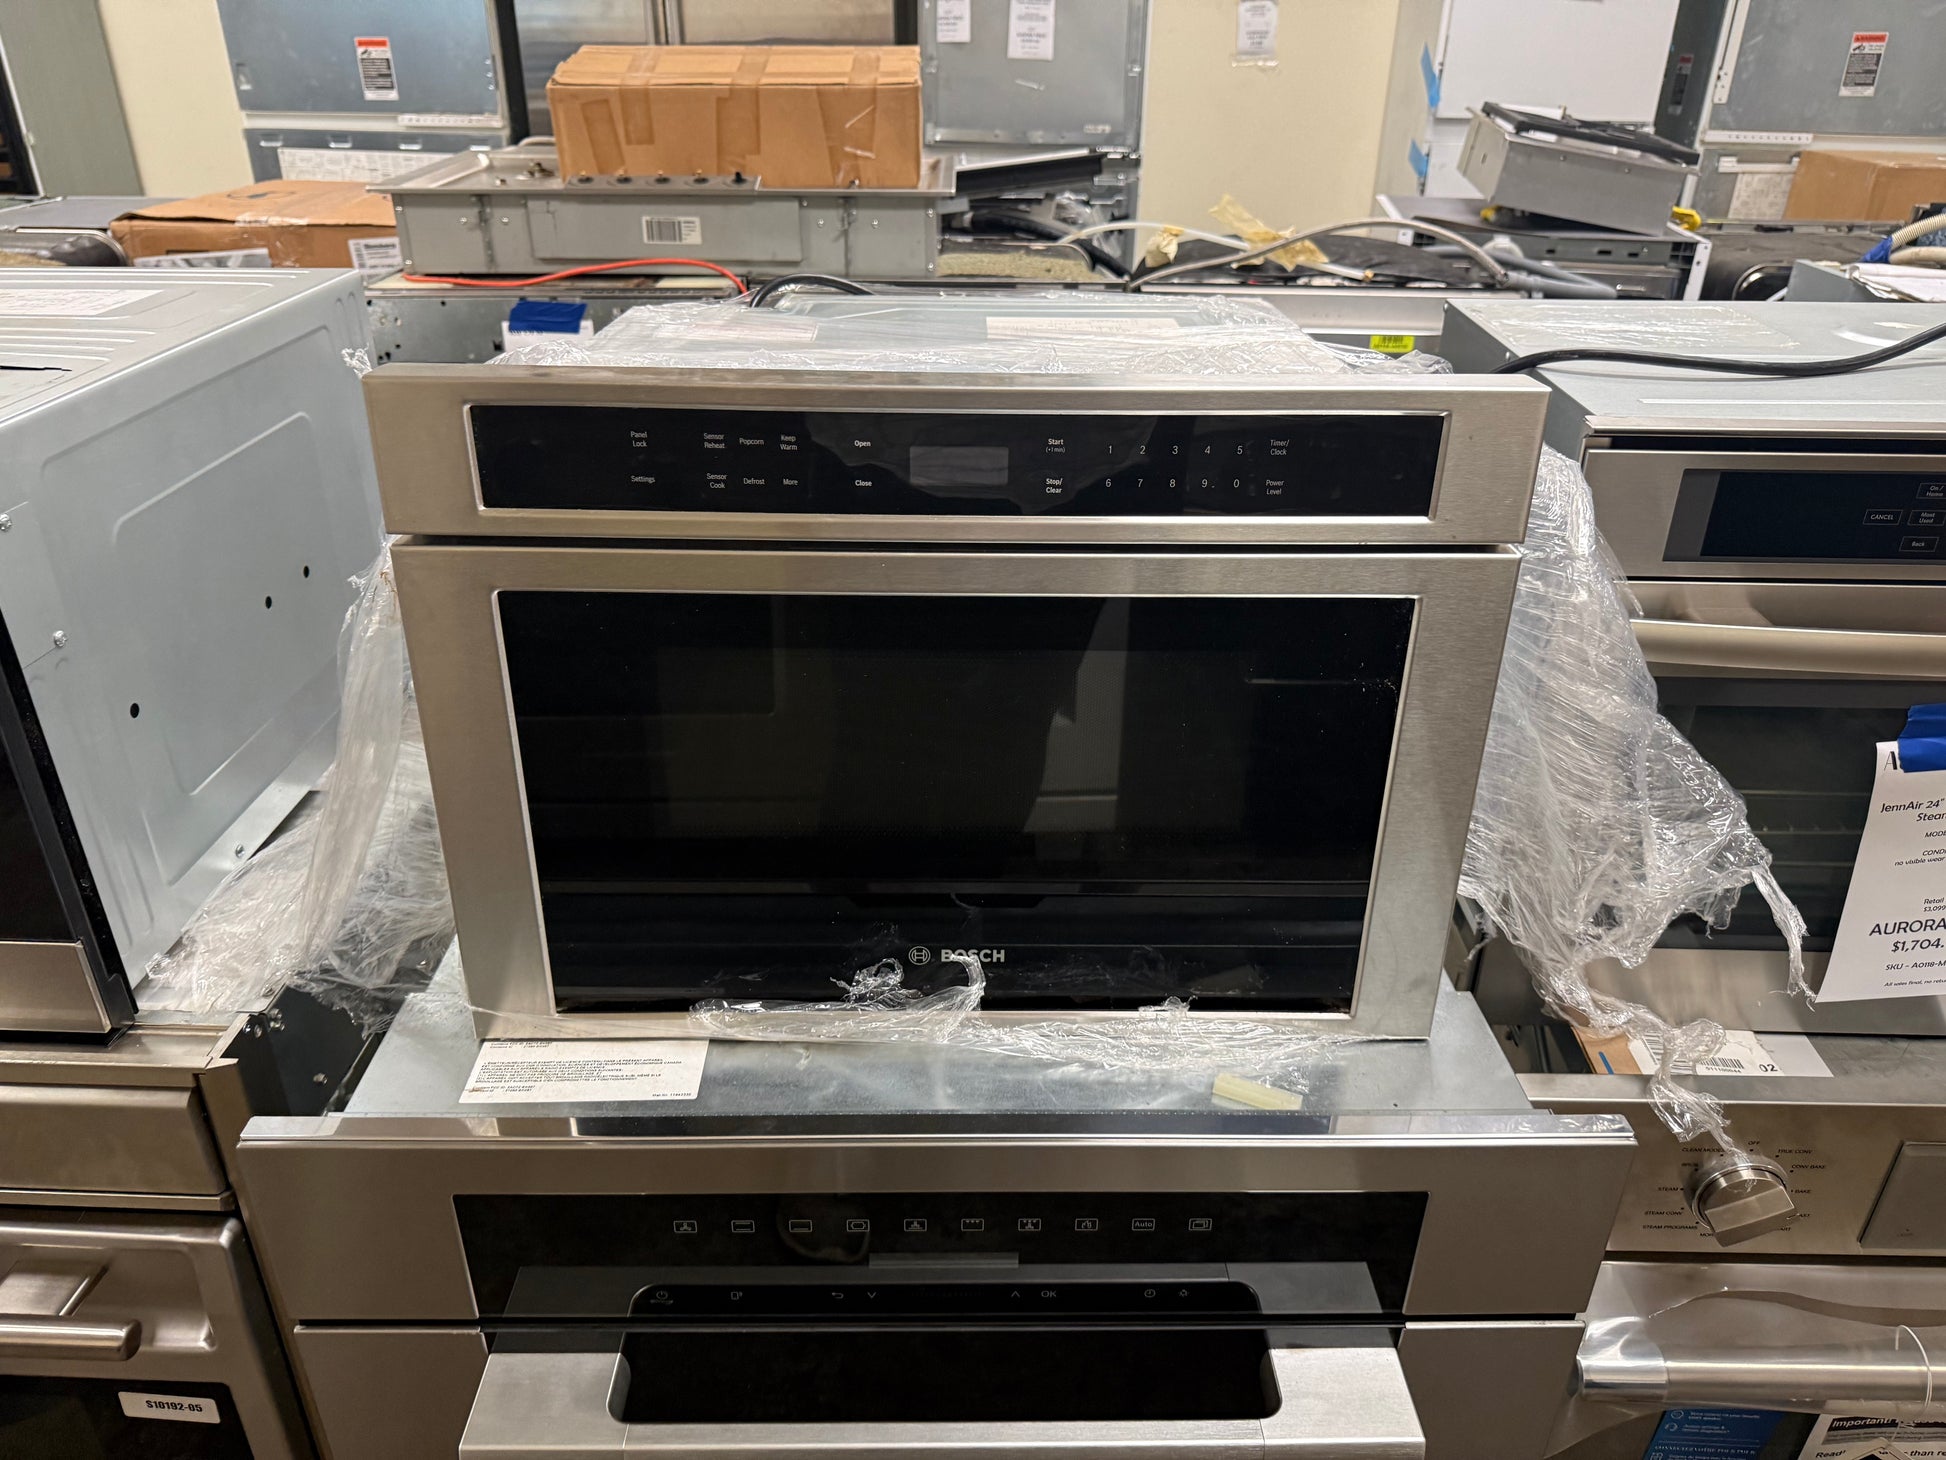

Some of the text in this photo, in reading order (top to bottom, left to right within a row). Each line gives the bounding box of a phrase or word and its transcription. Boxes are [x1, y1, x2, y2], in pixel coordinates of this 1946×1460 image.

[739, 438, 764, 447] Popcorn
[780, 434, 796, 443] Keep
[1270, 439, 1290, 447] Timer/
[632, 440, 647, 448] Lock
[704, 441, 725, 449] Reheat
[854, 440, 871, 448] Open
[1108, 446, 1113, 454] 1
[1140, 446, 1146, 455] 2
[1172, 446, 1178, 455] 3
[1204, 446, 1211, 455] 4
[1236, 446, 1243, 455] 5
[1270, 448, 1287, 456] Clock
[631, 475, 655, 484] Settings
[706, 473, 727, 481] Sensor
[1045, 477, 1063, 486] Stop/
[783, 478, 798, 486] More
[855, 479, 872, 487] Close
[1105, 479, 1112, 488] 6
[1137, 479, 1143, 488] 7
[1169, 479, 1176, 488] 8
[1201, 479, 1208, 488] 9
[1233, 479, 1240, 488] 0
[1265, 479, 1284, 487] Power
[1045, 486, 1062, 494] Clear
[1266, 488, 1282, 496] Level
[1880, 798, 1945, 813] JennAir 24"
[1923, 897, 1945, 905] Retail
[1891, 937, 1945, 953] $1,704.
[1885, 963, 1903, 971] SKU
[1759, 1063, 1778, 1073] 02
[1040, 1288, 1057, 1298] OK
[145, 1399, 203, 1413] S10192-05
